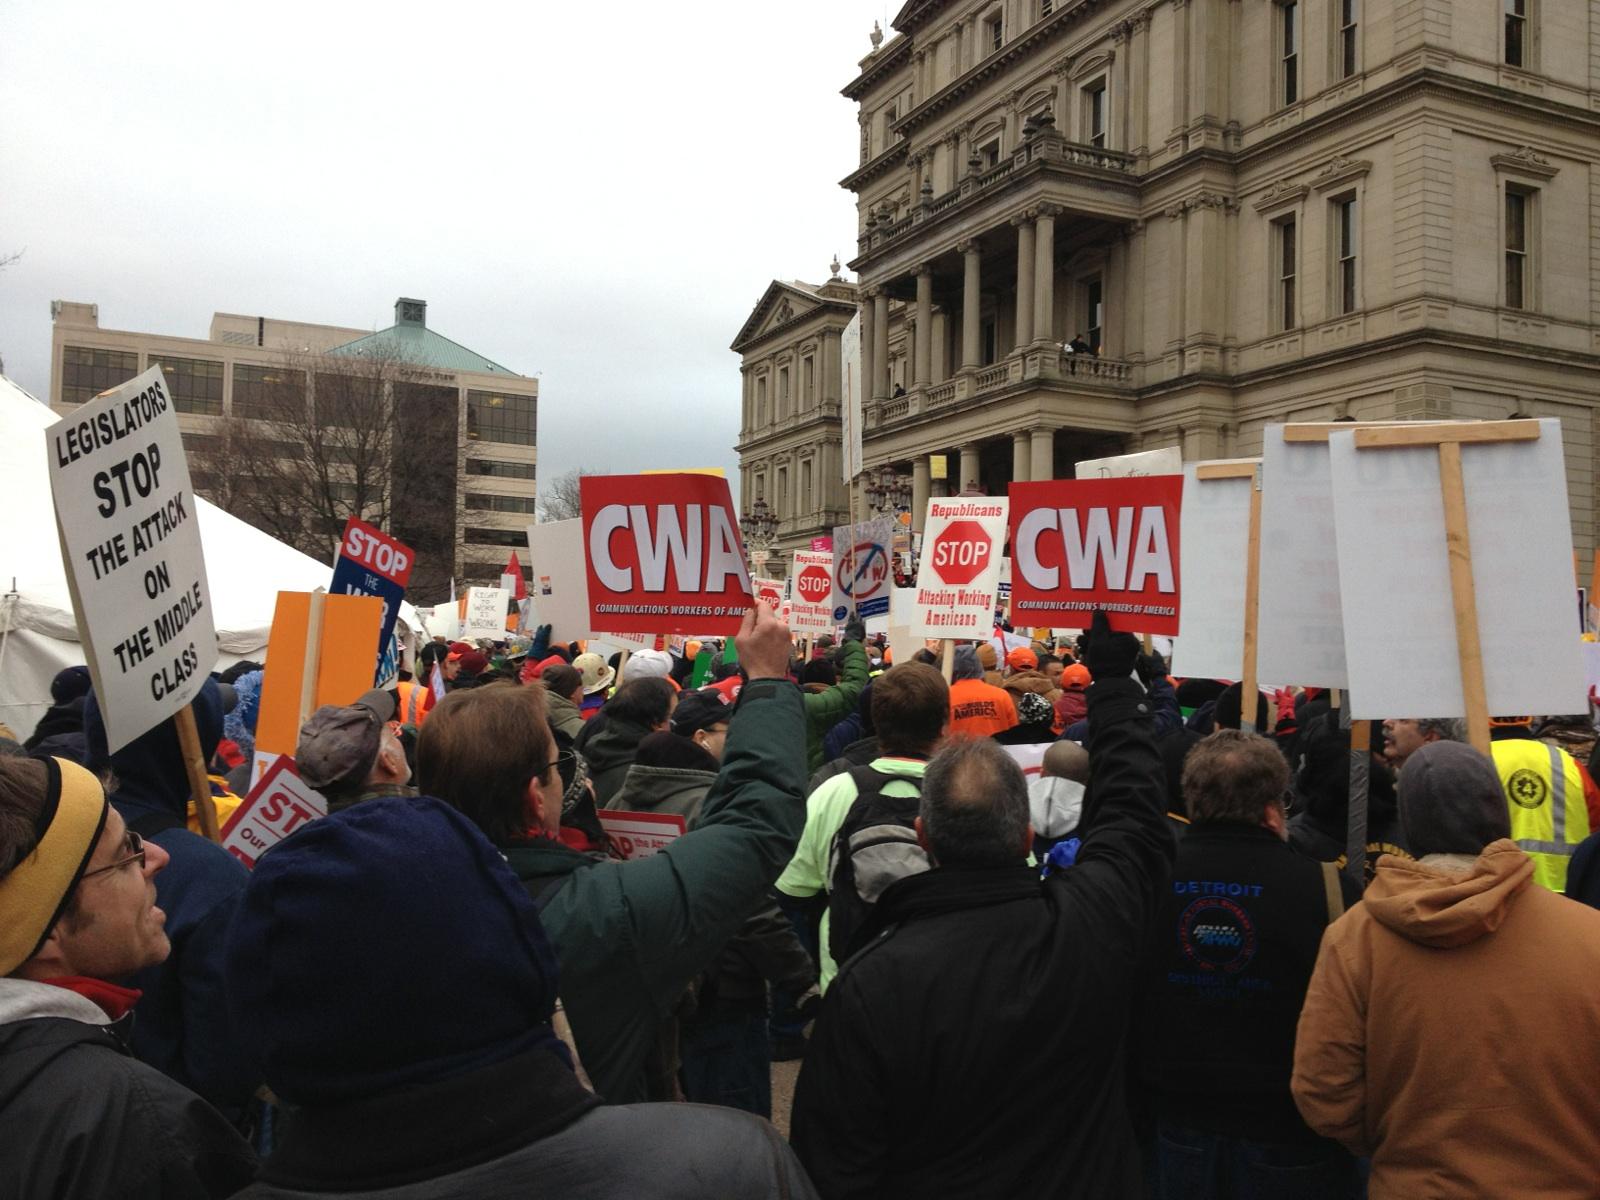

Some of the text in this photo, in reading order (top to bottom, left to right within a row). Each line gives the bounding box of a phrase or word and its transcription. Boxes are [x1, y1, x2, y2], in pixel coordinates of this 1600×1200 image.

[56, 380, 167, 468] LEGISLATORS
[93, 442, 162, 519] STOP
[931, 503, 1002, 519] Republicans
[86, 491, 187, 581] THE ATTACK
[346, 527, 408, 578] STOP
[590, 504, 751, 593] CWA
[796, 554, 833, 565] Republican
[935, 540, 988, 566] STOP
[1016, 506, 1175, 593] CWA
[144, 561, 171, 600] ON
[364, 573, 379, 591] THE
[799, 576, 830, 592] STOP
[595, 604, 669, 615] COMMUNICATIONS
[671, 605, 712, 616] WORKERS
[714, 607, 726, 616] OF
[918, 588, 956, 609] Attacking
[958, 588, 992, 610] Working
[1017, 600, 1175, 616] COMMUNICATIONS WORKERS OF AMERICA
[113, 580, 203, 674] THE MIDDLE
[926, 609, 977, 627] Americans
[150, 642, 199, 702] CLASS
[954, 707, 998, 720] AMERICA
[260, 792, 313, 834] ST
[240, 827, 266, 849] Our
[1173, 881, 1263, 897] DETROIT
